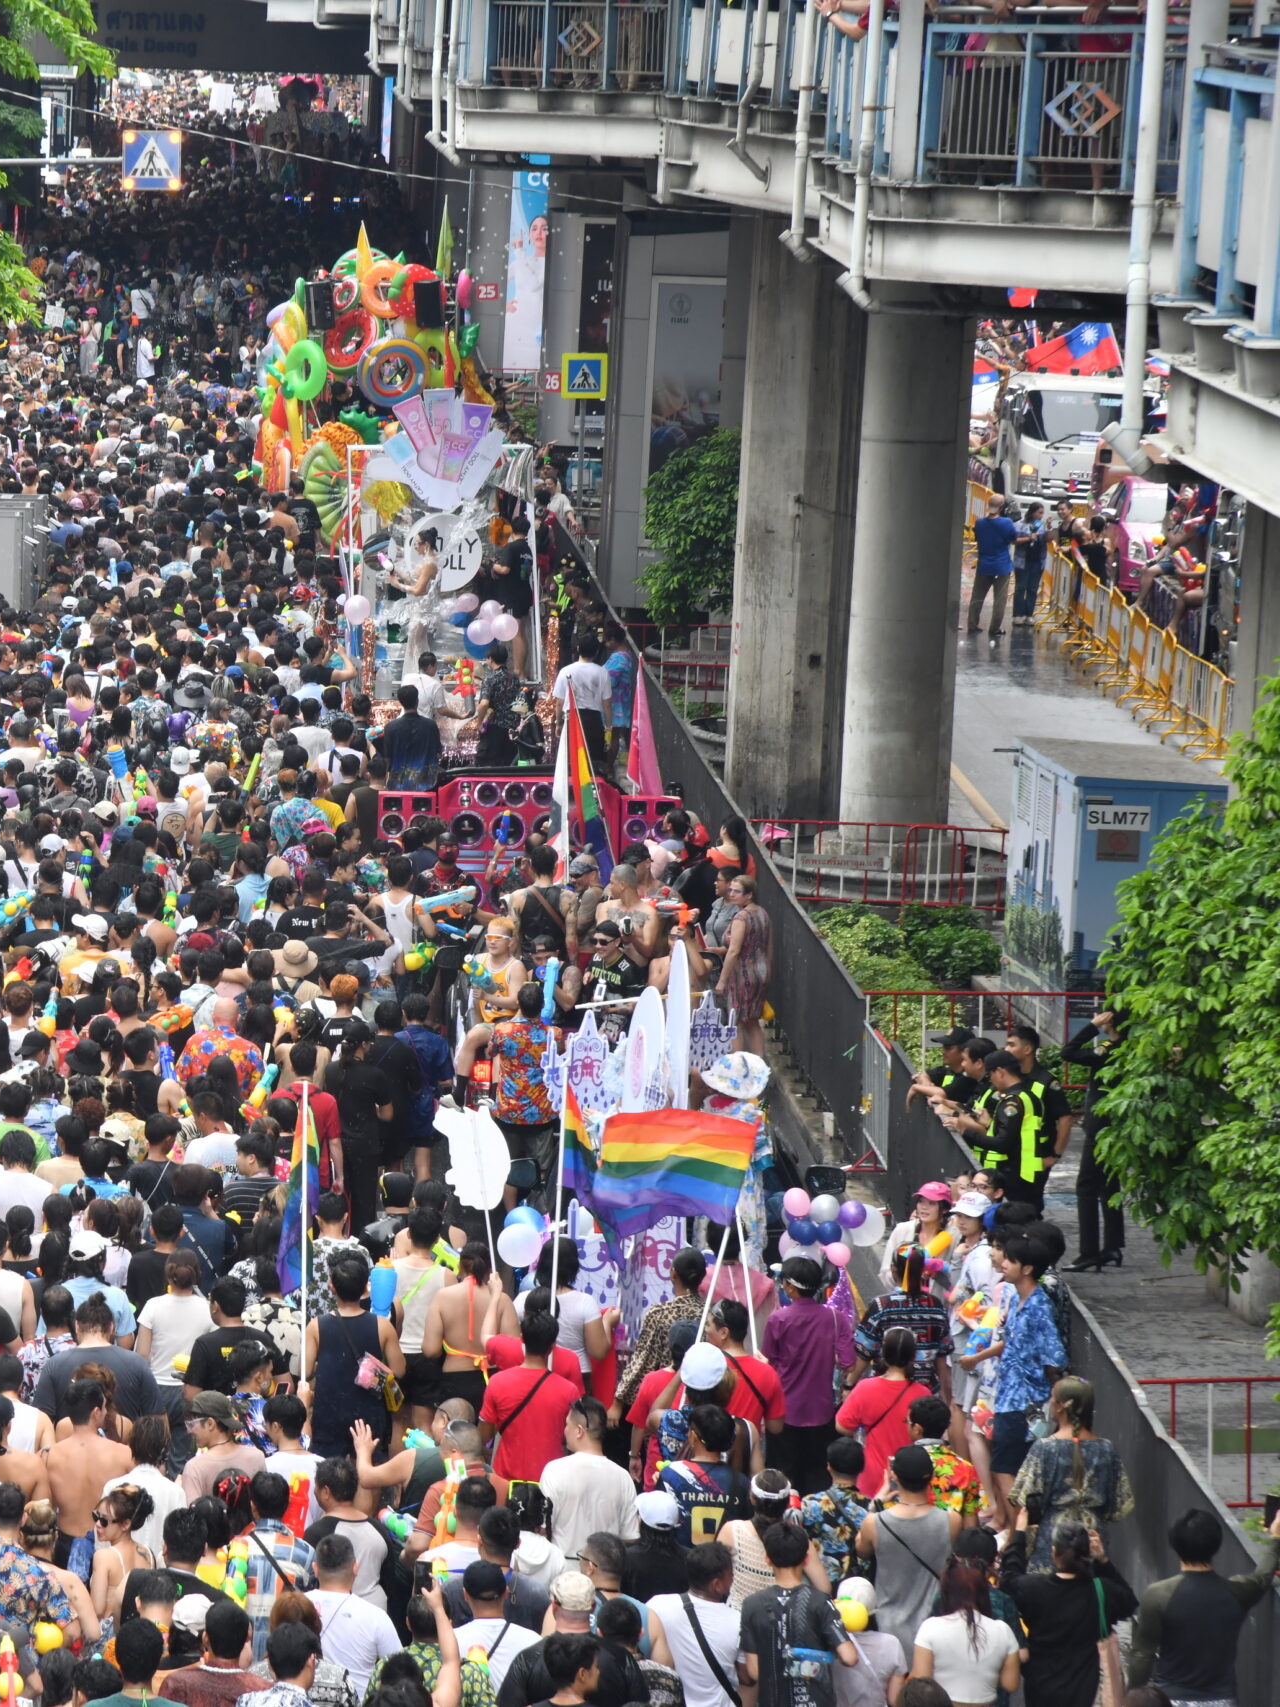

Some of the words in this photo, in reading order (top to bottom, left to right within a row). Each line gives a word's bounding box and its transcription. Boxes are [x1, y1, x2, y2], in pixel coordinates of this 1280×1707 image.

[143, 37, 197, 58] Daeng
[478, 285, 496, 299] 25
[545, 375, 560, 390] 26
[1088, 810, 1149, 825] SLM77
[291, 917, 309, 926] New
